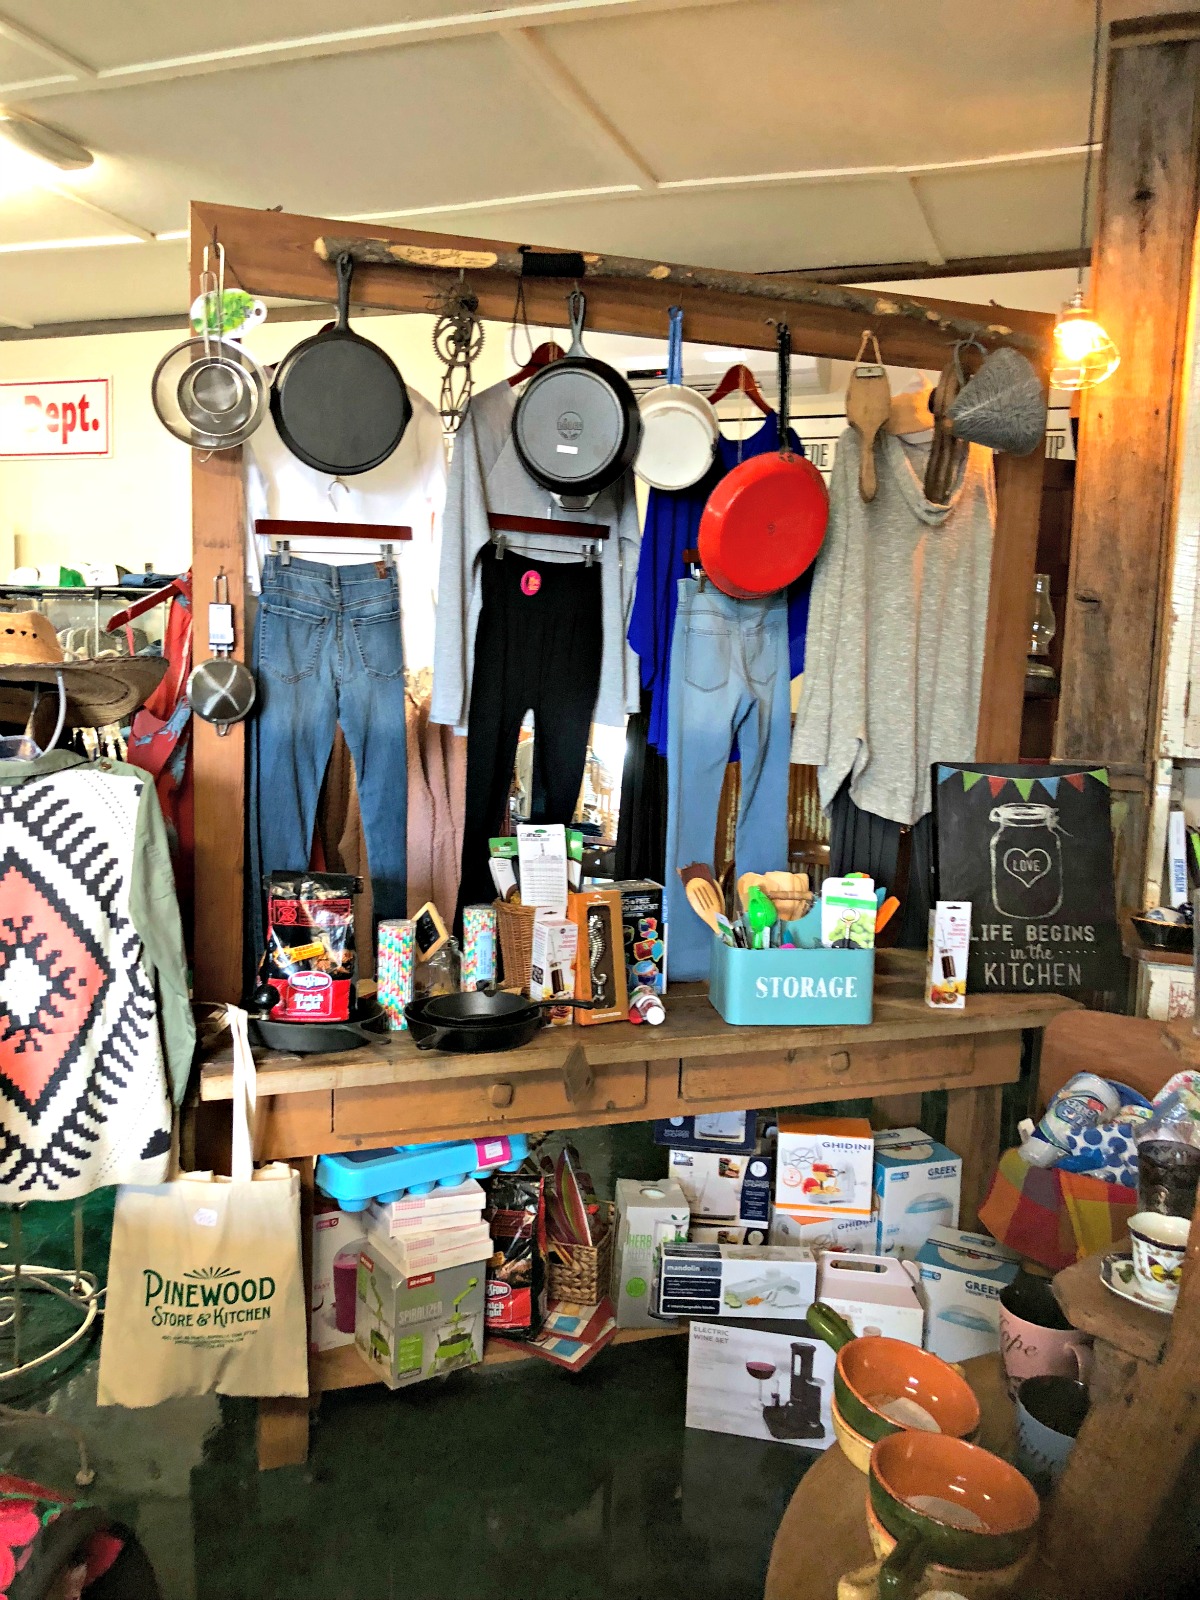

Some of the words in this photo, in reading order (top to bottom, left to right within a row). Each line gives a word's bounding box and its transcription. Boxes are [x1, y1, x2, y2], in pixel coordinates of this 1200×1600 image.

[1012, 859, 1041, 872] LOVE
[1173, 858, 1185, 893] JERUSALEM
[1026, 924, 1096, 942] BEGINS
[1010, 943, 1025, 960] in
[1025, 943, 1054, 960] the
[984, 962, 1082, 986] KITCHEN
[755, 976, 858, 999] STORAGE
[821, 1141, 871, 1151] GHIDINI
[928, 1165, 957, 1177] GREEK
[628, 1234, 653, 1250] HERB
[143, 1269, 276, 1308] PINEWOOD
[151, 1305, 194, 1327] STORE
[197, 1312, 212, 1327] &
[213, 1305, 272, 1328] KITCHEN
[398, 1301, 443, 1325] SPIRALIZER
[693, 1325, 729, 1337] ELECTRIC
[693, 1333, 713, 1342] WINE
[714, 1336, 729, 1344] SET
